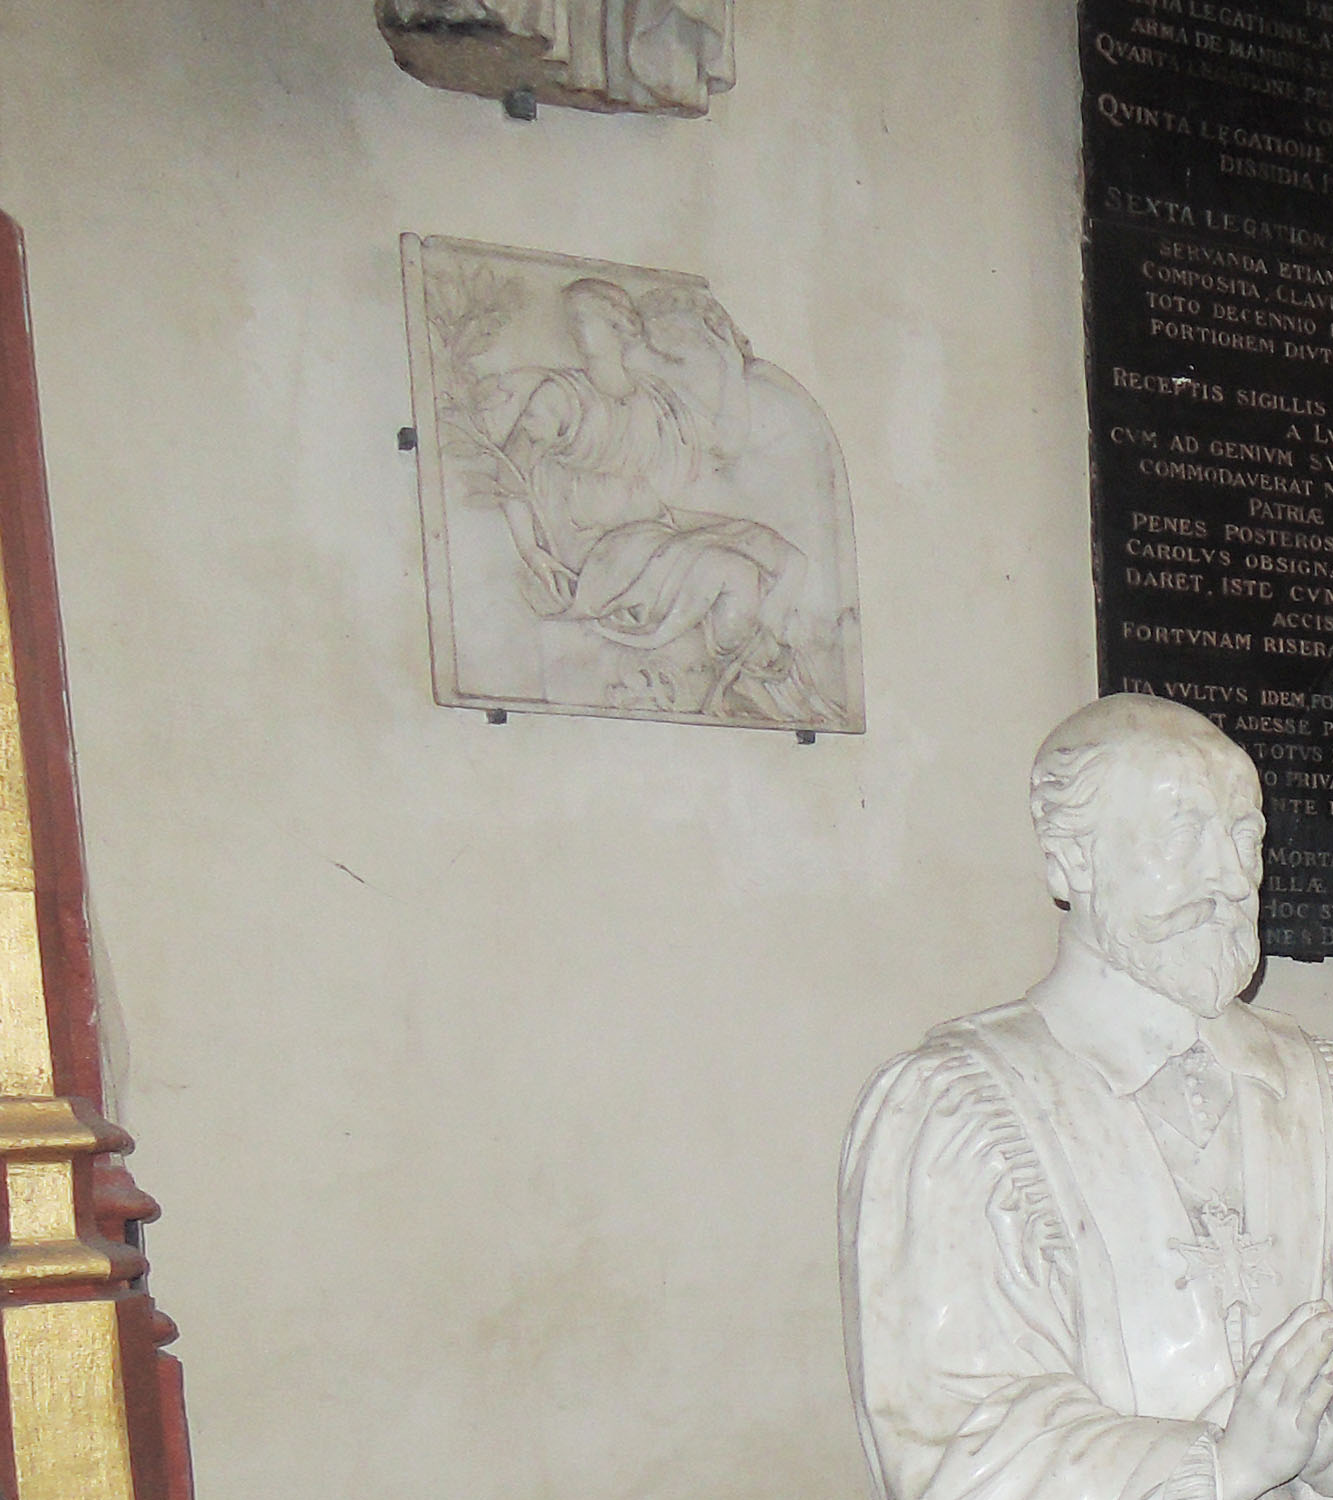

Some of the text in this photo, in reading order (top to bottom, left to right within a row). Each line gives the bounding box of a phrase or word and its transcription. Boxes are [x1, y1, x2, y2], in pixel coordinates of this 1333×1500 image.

[1097, 92, 1191, 132] QVINTA
[1105, 186, 1194, 225] SEXTA
[1146, 291, 1199, 314] TOTO
[1237, 389, 1325, 415] SIGILLIS
[1287, 423, 1300, 440] A
[1170, 434, 1198, 453] AD
[1209, 441, 1292, 466] GENIVM
[1140, 460, 1311, 496] COMMODAVERAT
[1133, 512, 1206, 537] PENES
[1126, 538, 1230, 565] CAROLVS
[1123, 621, 1251, 650] FORTVNAM
[1166, 681, 1248, 701] VVLTVS
[1235, 715, 1310, 733] ADESSE
